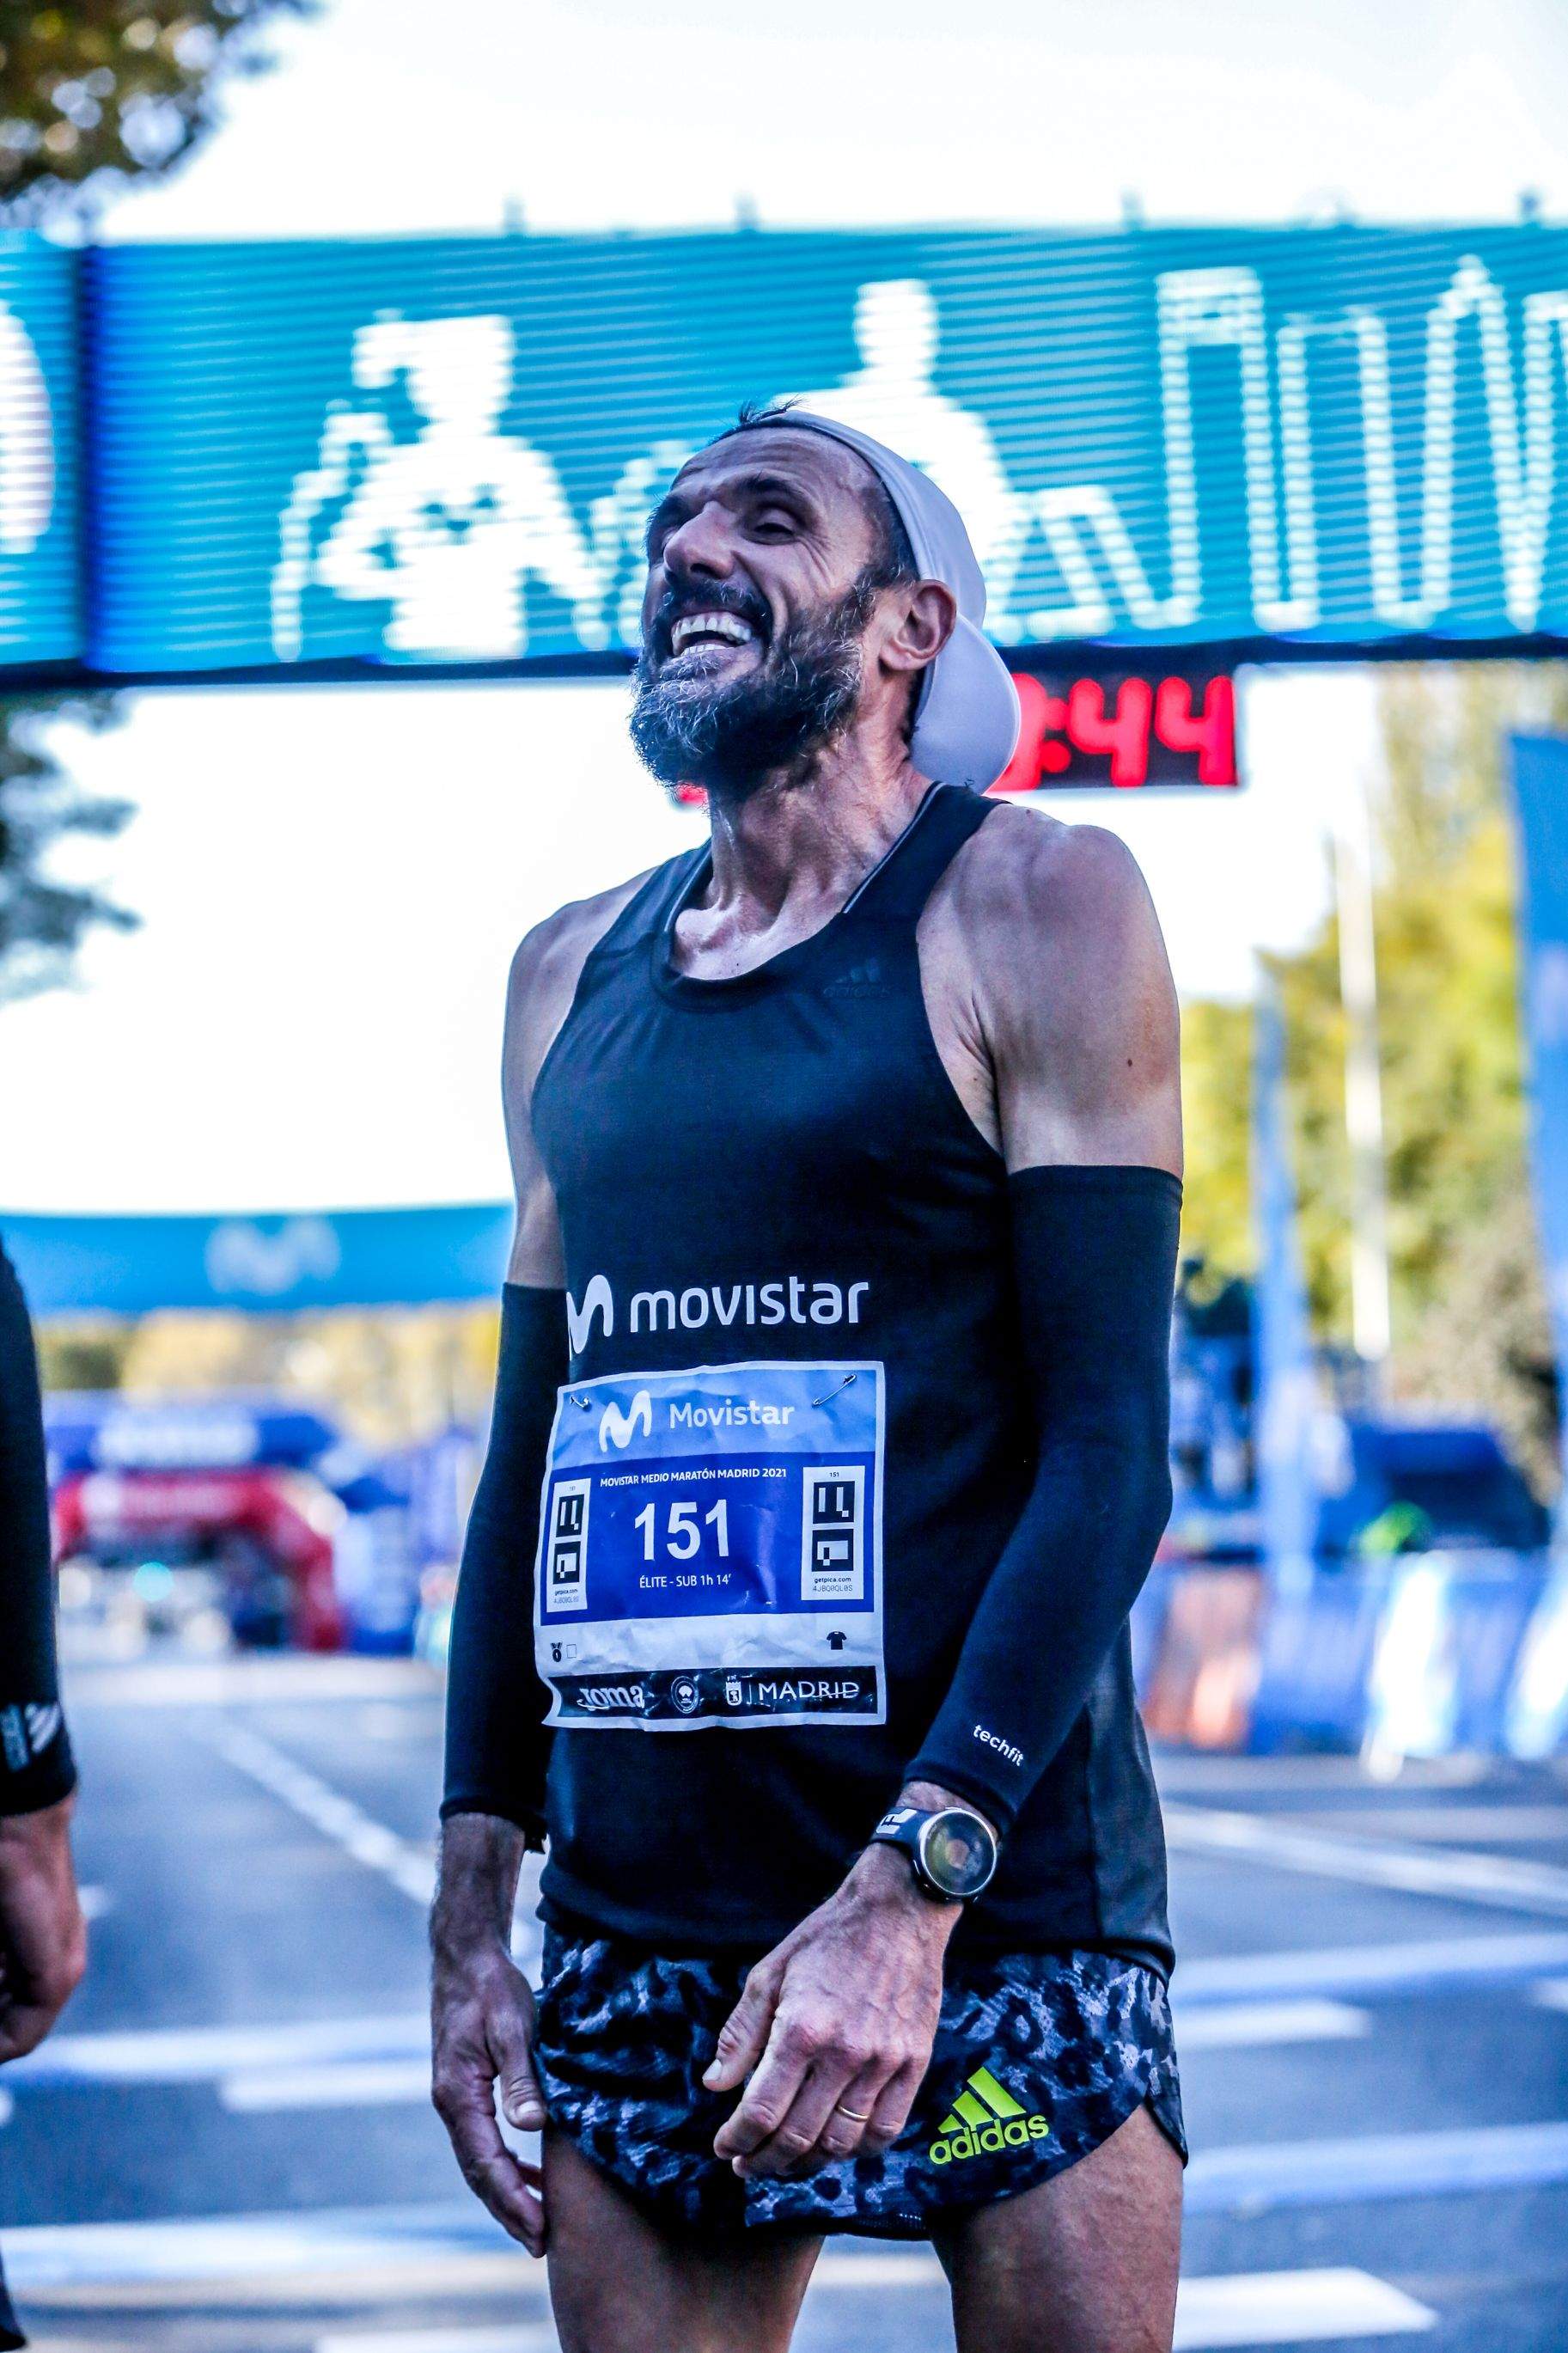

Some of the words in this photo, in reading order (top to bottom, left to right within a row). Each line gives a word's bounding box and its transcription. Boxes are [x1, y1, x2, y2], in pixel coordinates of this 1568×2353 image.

[630, 1275, 869, 1333] movistar
[669, 1398, 796, 1430] Movistar
[600, 1475, 639, 1488] MOVISTAR
[641, 1472, 669, 1484] MEDIO
[670, 1468, 716, 1482] MARATÓN
[717, 1469, 760, 1479] MADRID
[762, 1468, 787, 1478] 2021
[634, 1499, 729, 1562] 151
[639, 1574, 668, 1588] ÉLITE
[676, 1574, 698, 1587] SUB
[700, 1574, 714, 1586] 1h
[758, 1680, 860, 1702] MADRID
[973, 1724, 1025, 1767] techfit
[929, 2114, 1050, 2166] adidas
